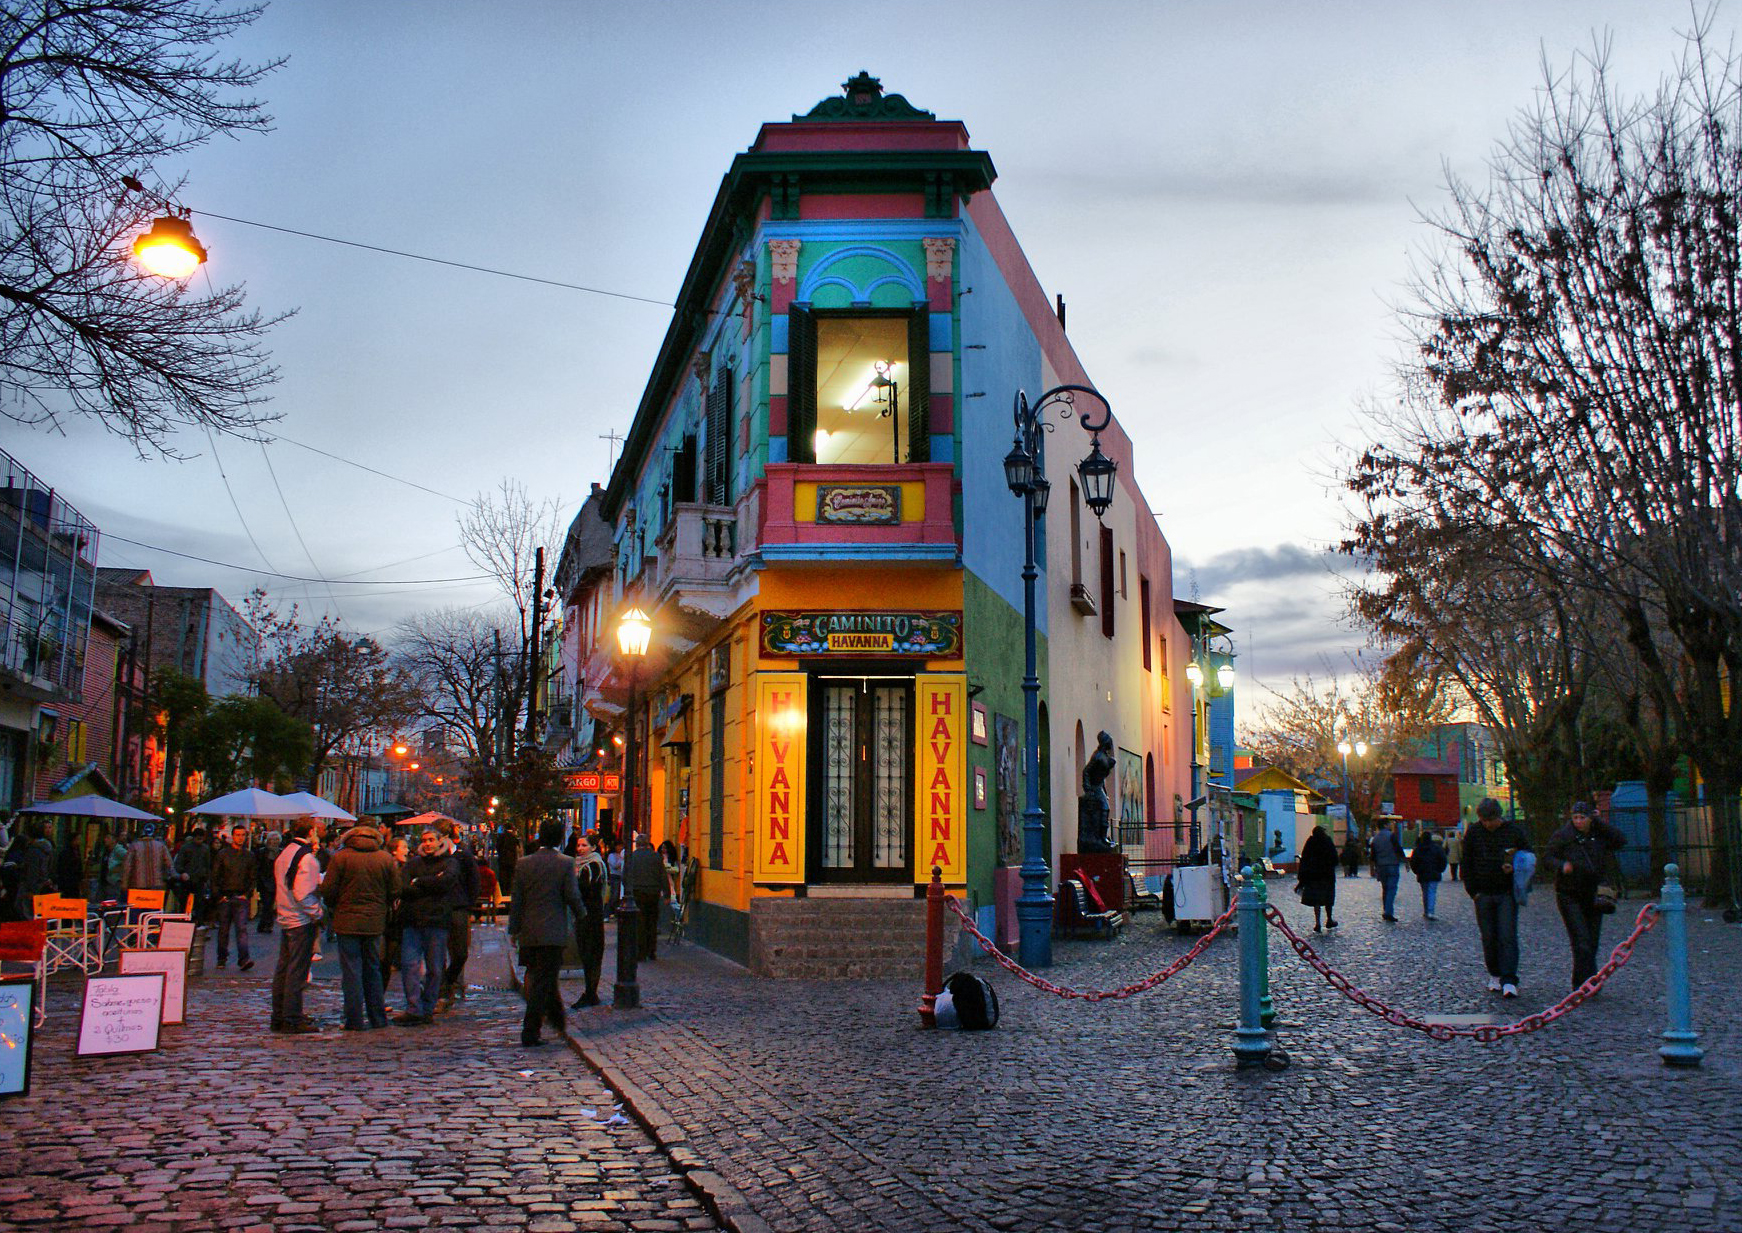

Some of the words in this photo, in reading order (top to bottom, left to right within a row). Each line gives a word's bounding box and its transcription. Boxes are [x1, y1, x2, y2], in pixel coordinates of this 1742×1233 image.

[815, 616, 909, 637] CAMINITO
[832, 635, 890, 648] HAVANNA
[769, 691, 792, 865] HVANNA
[930, 692, 951, 866] HAVANNA
